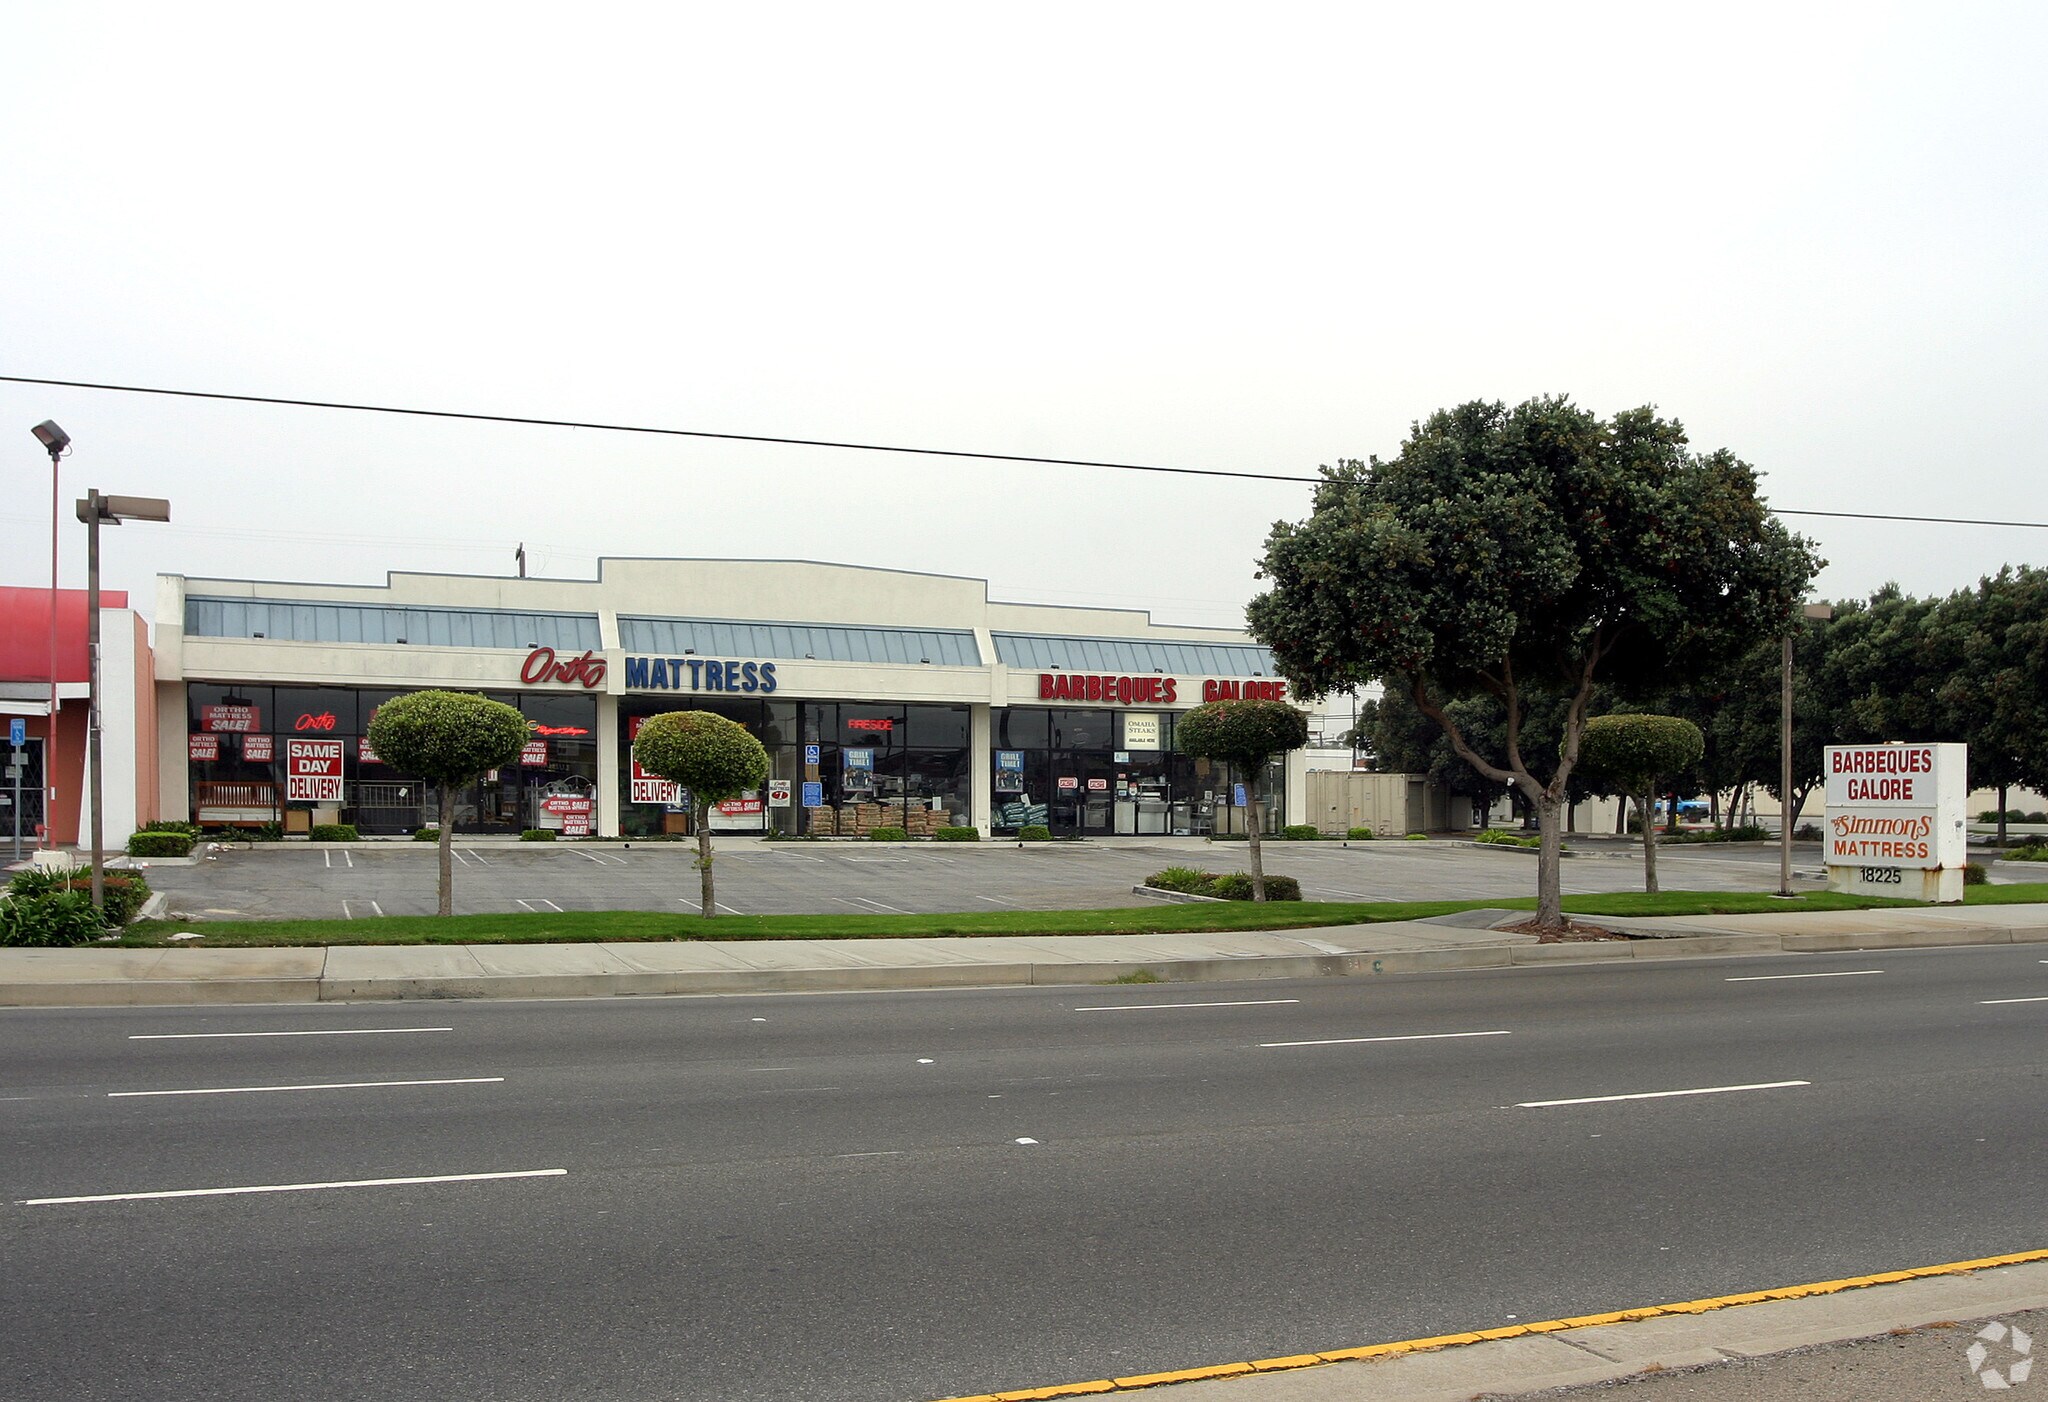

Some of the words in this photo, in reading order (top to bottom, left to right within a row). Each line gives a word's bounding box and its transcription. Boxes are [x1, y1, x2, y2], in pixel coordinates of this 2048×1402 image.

[520, 647, 607, 689] Ortho
[625, 657, 777, 693] MATTRESS
[1038, 673, 1177, 705] BARBEQUES
[211, 720, 251, 731] SALE!
[294, 711, 336, 731] Ortho
[191, 748, 217, 758] SALE!
[246, 749, 271, 760] SALE!
[291, 744, 340, 758] SAME
[522, 753, 545, 763] SALE!
[299, 760, 331, 773] DAY
[1832, 749, 1932, 775] BARBEQUES
[290, 778, 341, 799] DELIVERY
[633, 781, 679, 801] DELIVERY
[1847, 778, 1913, 800] GALORE
[571, 801, 590, 810] SALE!
[744, 801, 761, 811] SALE!
[565, 825, 588, 835] SALE!
[1834, 840, 1929, 859] MATTRESS
[1860, 868, 1902, 884] 18225
